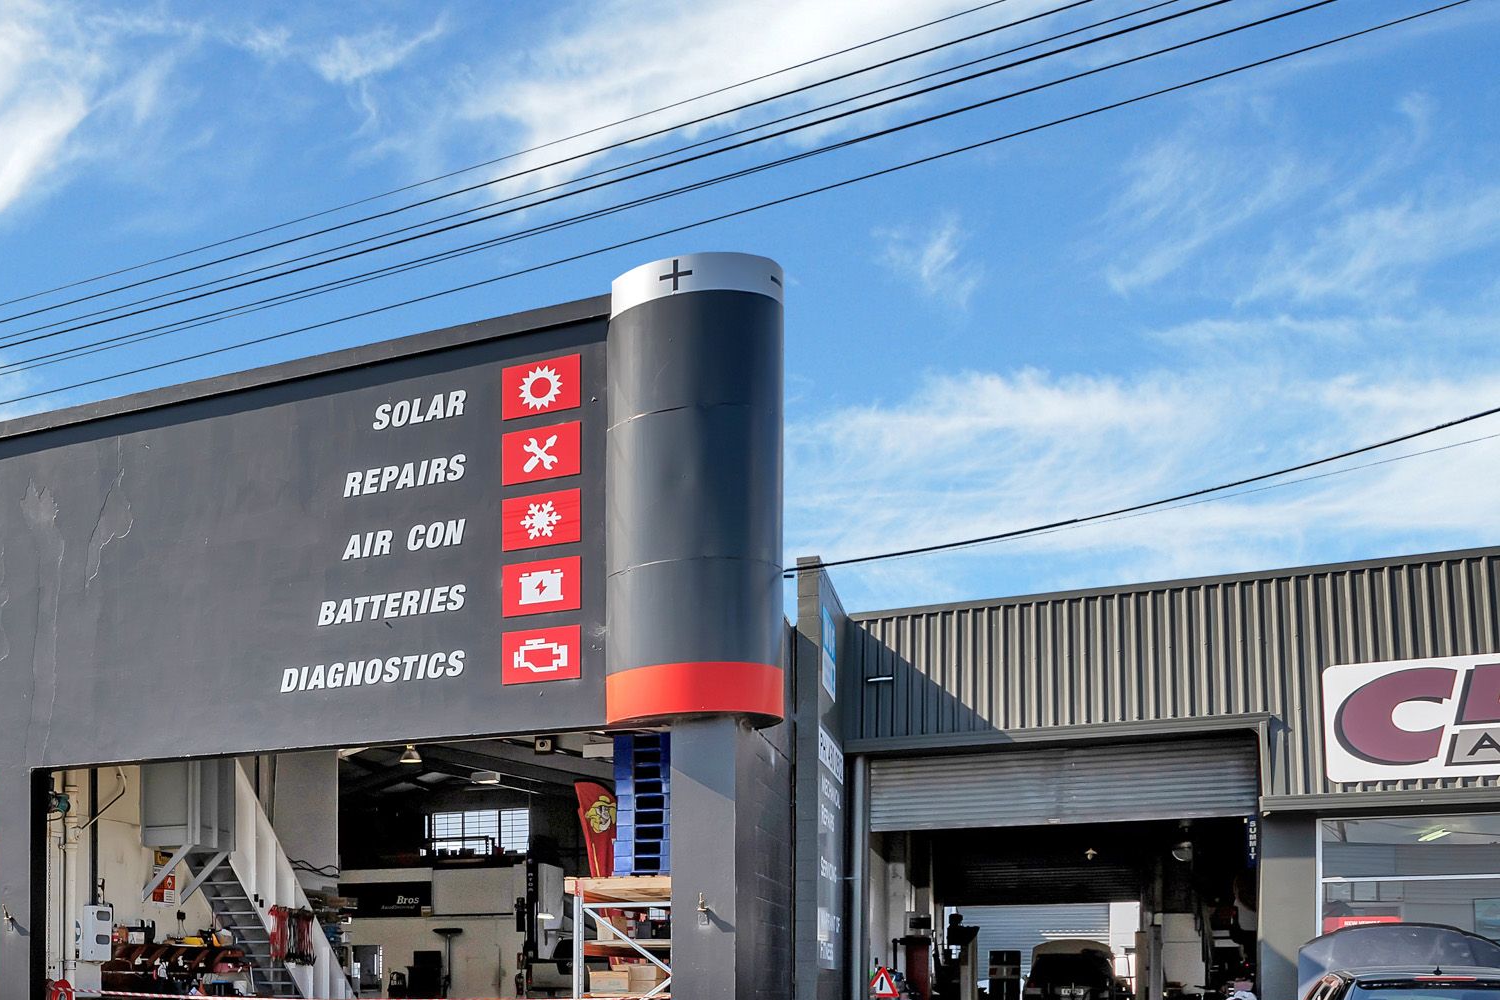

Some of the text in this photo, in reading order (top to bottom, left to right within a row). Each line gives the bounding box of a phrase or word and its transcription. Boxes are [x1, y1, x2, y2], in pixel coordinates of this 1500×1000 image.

[372, 389, 467, 431] SOLAR
[342, 453, 467, 498] REPAIRS
[341, 518, 467, 561] AIR CON
[316, 584, 467, 627] BATTERIES
[280, 649, 466, 694] DIAGNOSTICS
[1249, 820, 1257, 860] SUMMIT
[396, 895, 420, 905] Bros
